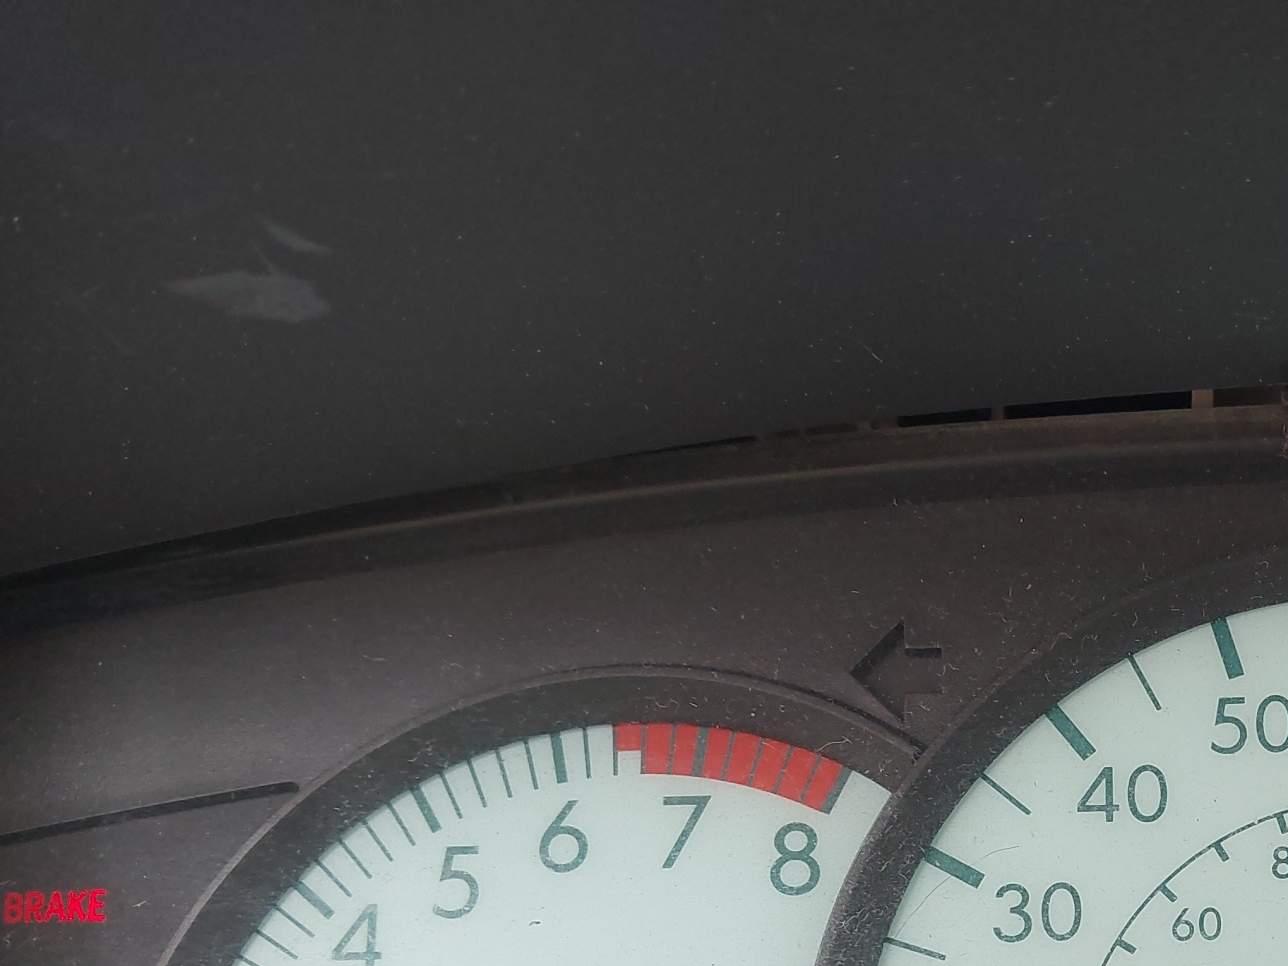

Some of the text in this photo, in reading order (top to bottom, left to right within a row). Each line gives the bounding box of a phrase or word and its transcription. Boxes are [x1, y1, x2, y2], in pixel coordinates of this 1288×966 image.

[1077, 765, 1169, 823] 40
[539, 800, 588, 873] 6
[662, 795, 712, 868] 7
[770, 823, 821, 896] 8
[3, 889, 107, 924] BRAKE
[432, 845, 480, 919] 5
[992, 881, 1082, 943] 30
[1171, 907, 1222, 941] 60
